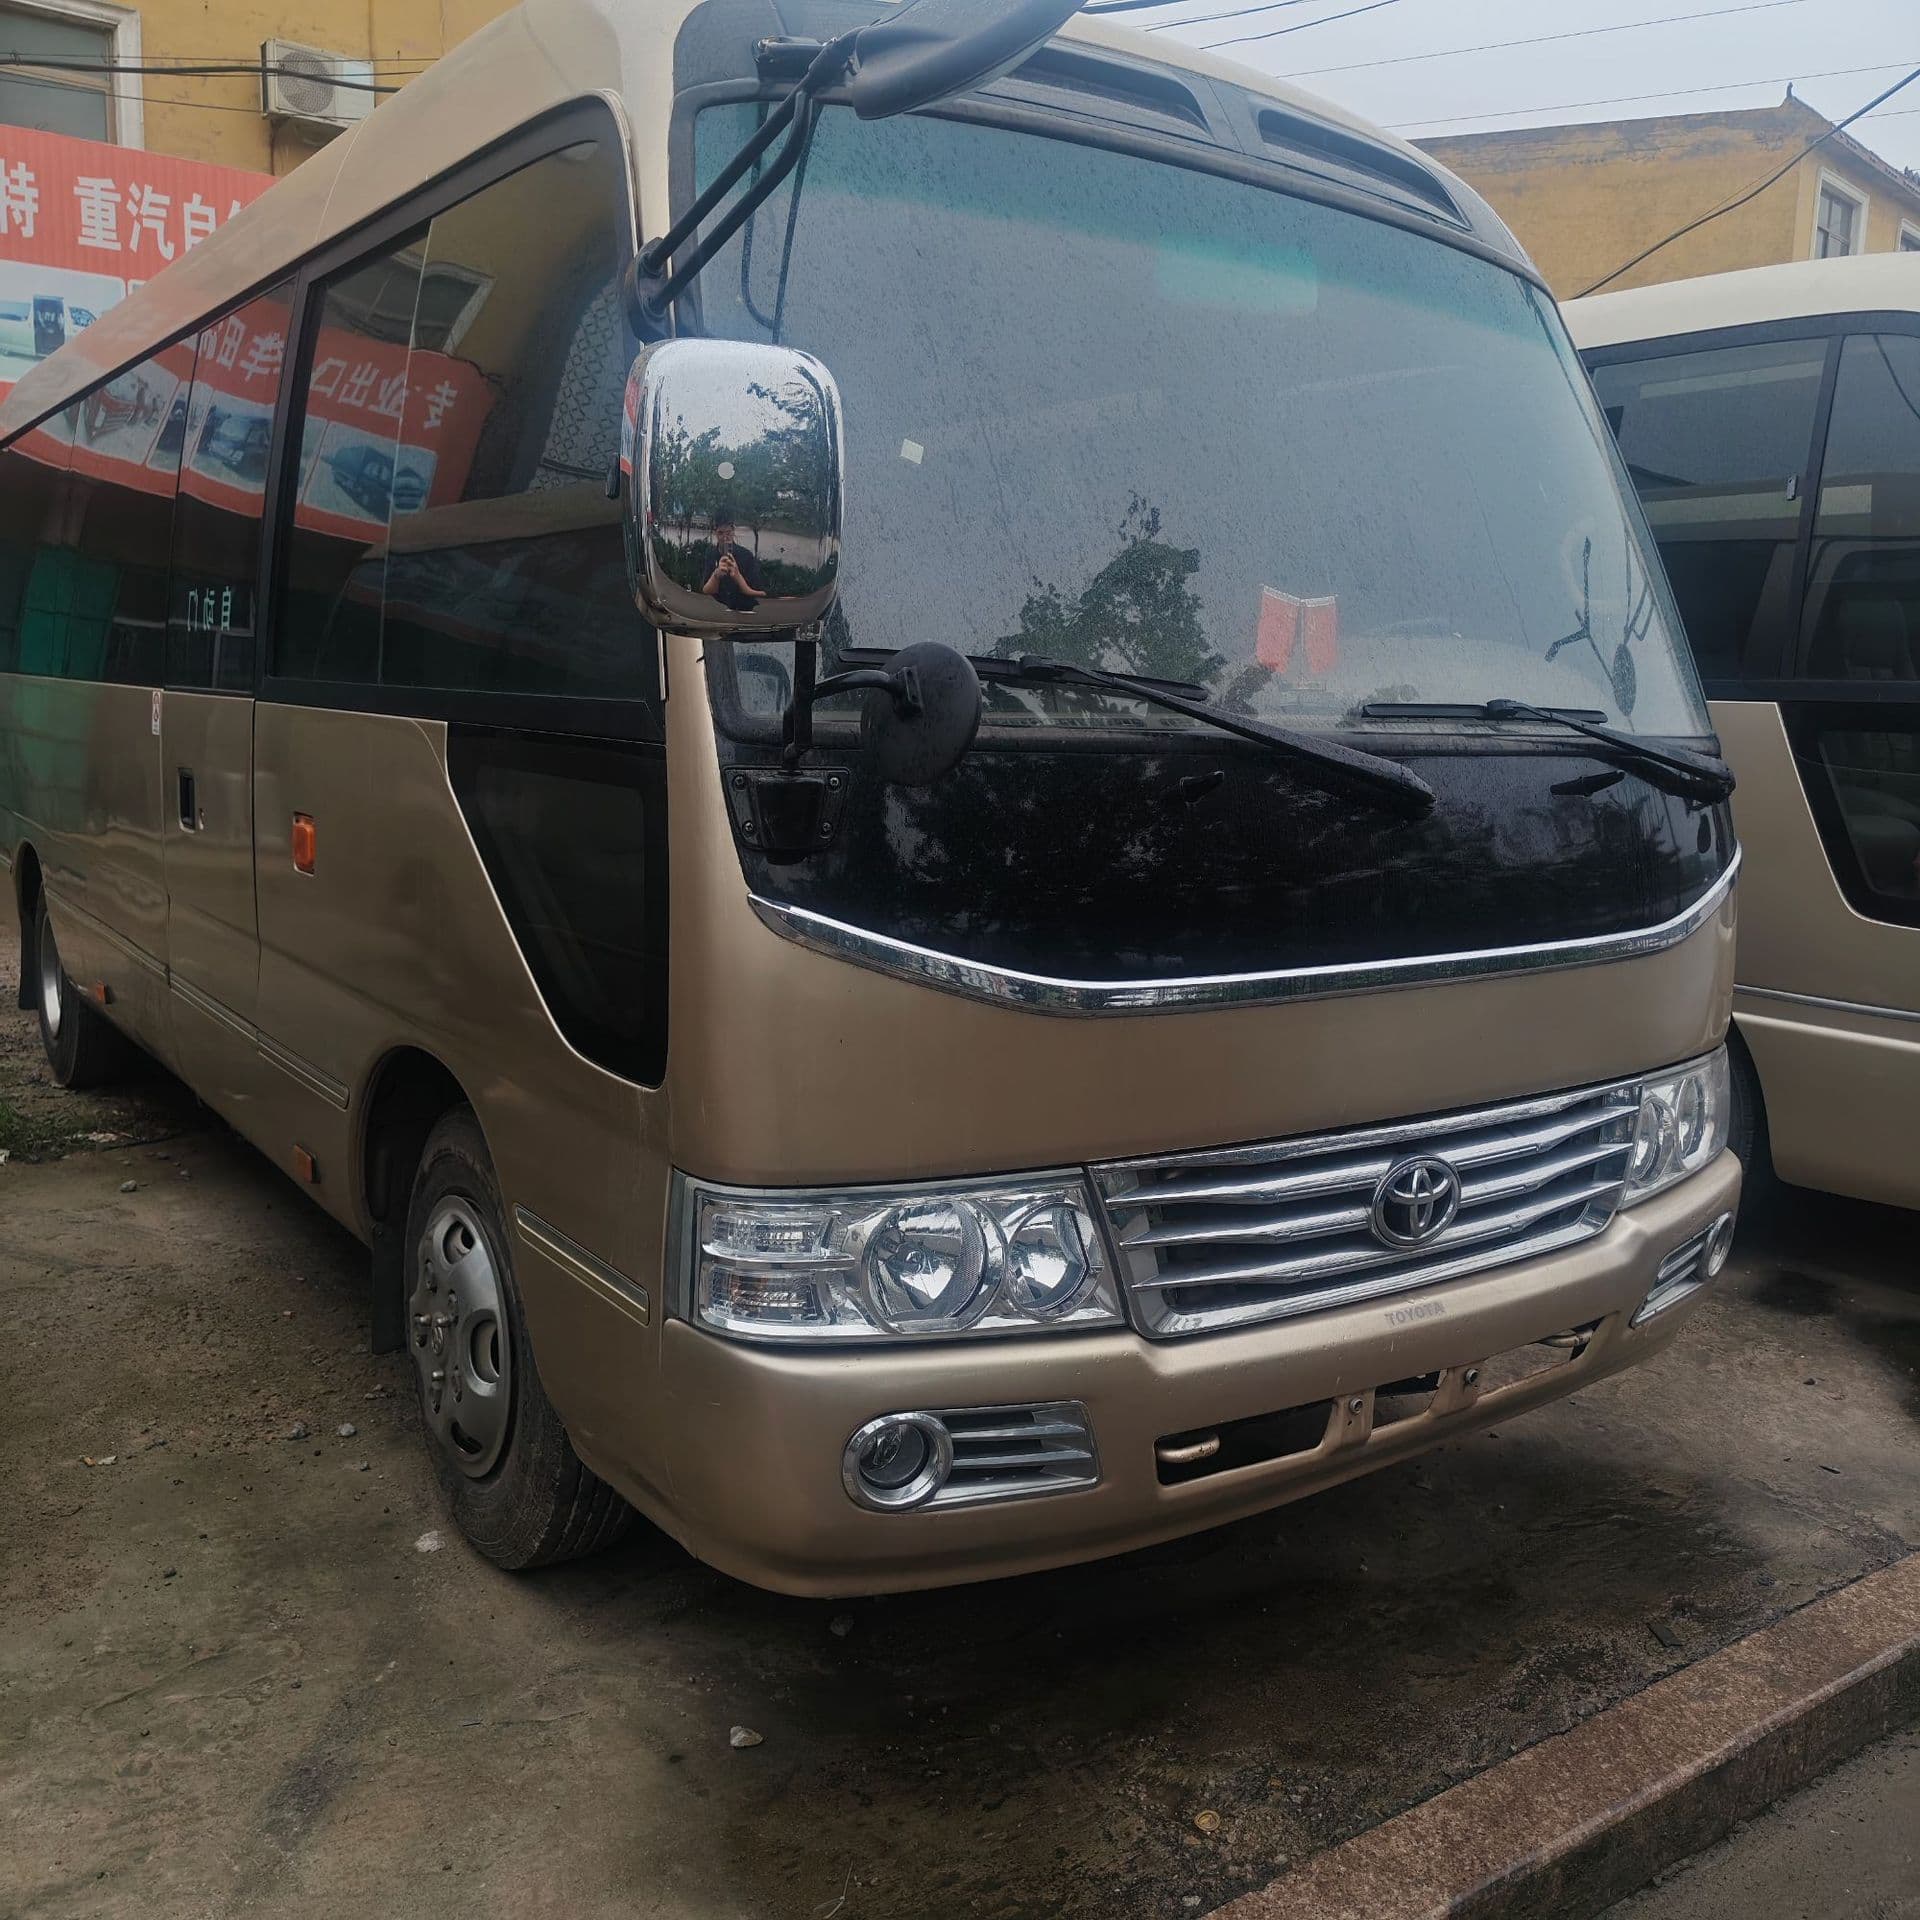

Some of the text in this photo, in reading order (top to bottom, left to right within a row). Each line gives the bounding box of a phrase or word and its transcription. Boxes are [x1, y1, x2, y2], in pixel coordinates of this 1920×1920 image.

[73, 175, 241, 261] 重汽自
[1384, 1302, 1446, 1326] TOYOTA
